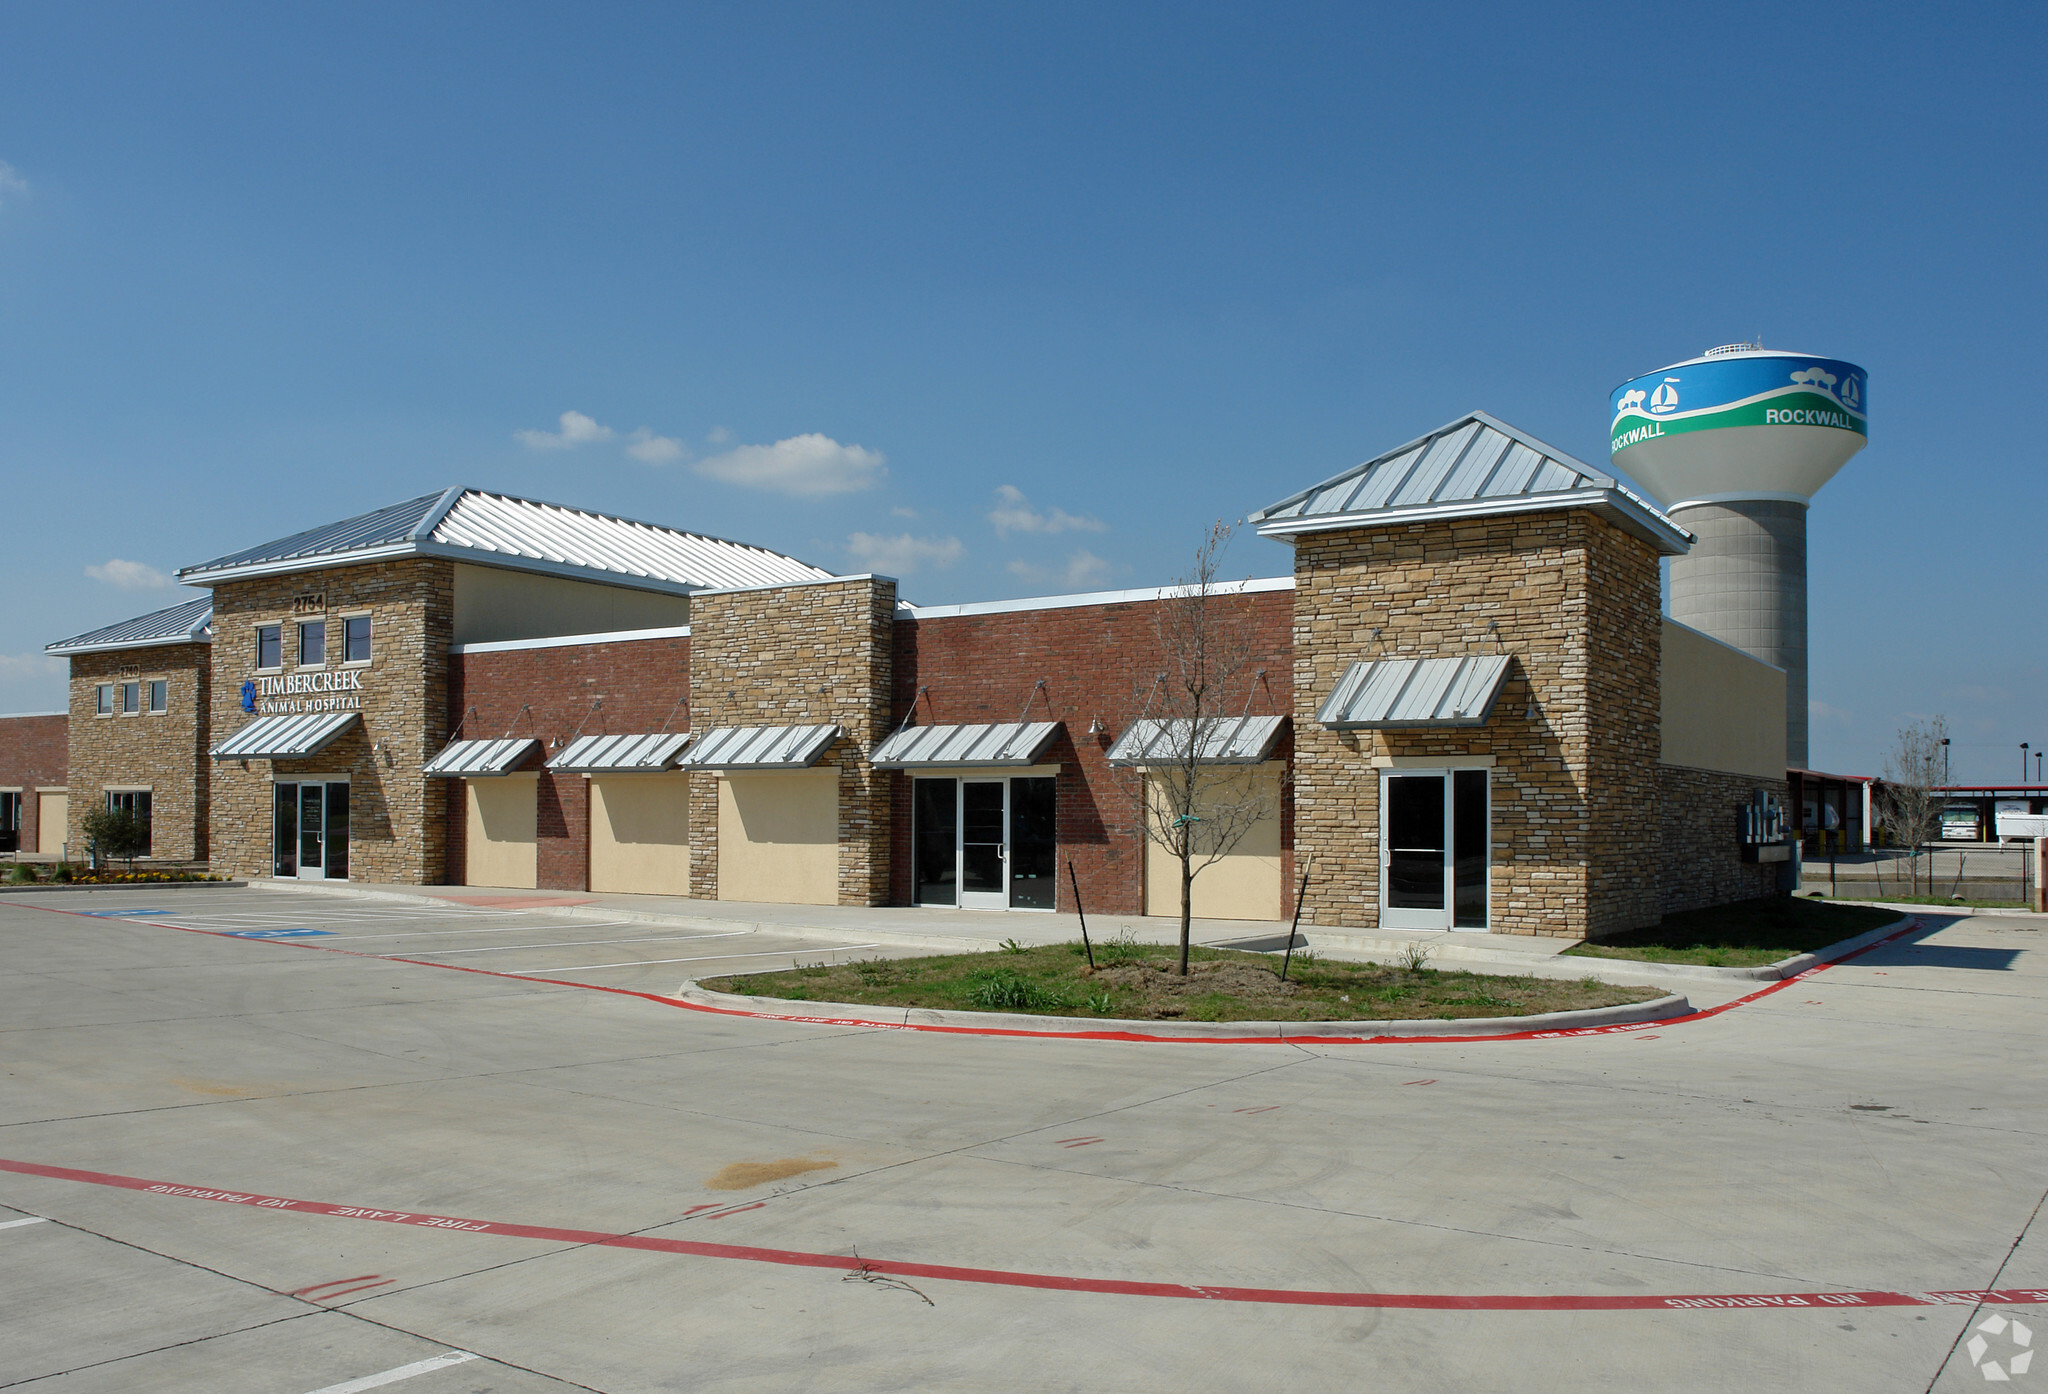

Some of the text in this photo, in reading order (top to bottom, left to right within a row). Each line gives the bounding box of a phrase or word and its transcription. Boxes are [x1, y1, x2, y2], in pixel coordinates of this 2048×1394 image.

[1766, 408, 1852, 429] ROCKWALL
[294, 594, 324, 612] 2754
[259, 670, 363, 696] TIMBERCREEK
[260, 696, 361, 713] ANIMAL HOSPITAL
[143, 1184, 491, 1232] FIRE LANE NO PARKING
[1664, 1295, 1811, 1308] PARKING
[1817, 1294, 1868, 1305] NO
